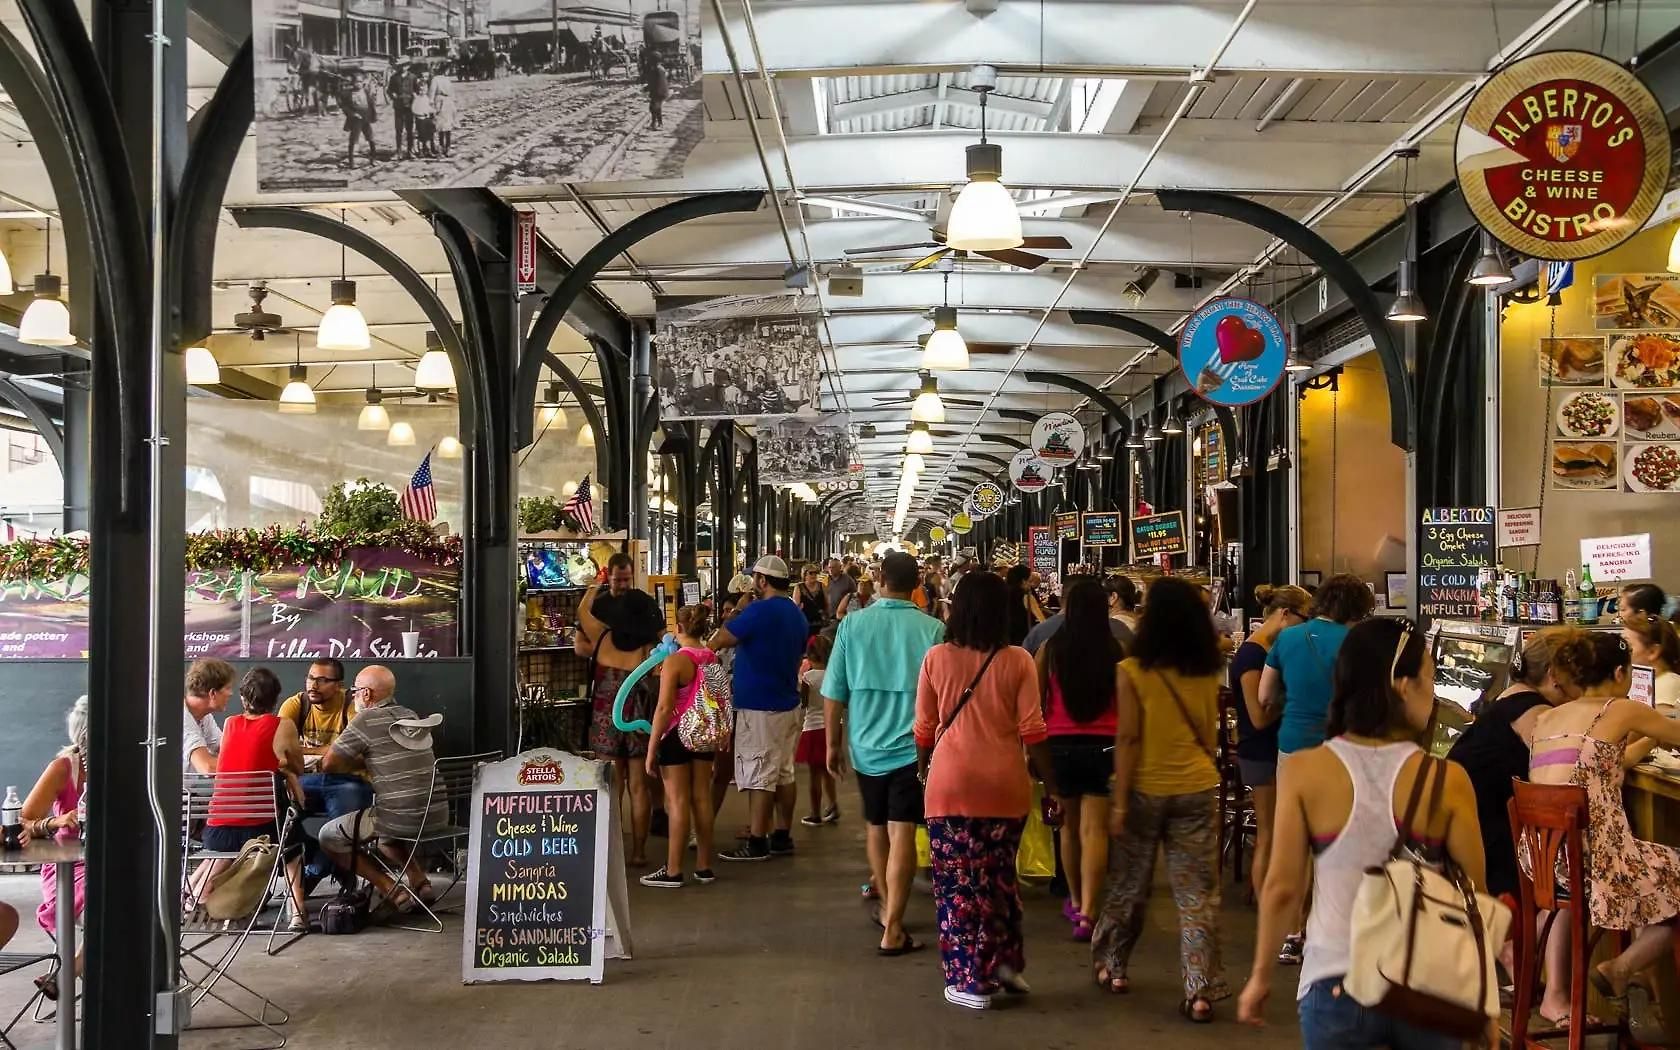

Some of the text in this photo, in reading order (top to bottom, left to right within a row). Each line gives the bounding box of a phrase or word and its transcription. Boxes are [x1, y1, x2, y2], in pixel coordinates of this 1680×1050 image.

[1494, 88, 1634, 148] ALBERTO'S
[1522, 169, 1604, 183] CHEESE
[1525, 186, 1598, 200] & WINE
[1504, 196, 1616, 238] BISTRO
[1645, 432, 1677, 440] Reuben
[976, 484, 997, 492] CAJUN
[1422, 508, 1493, 523] ALBERTOS
[1428, 528, 1484, 542] 3 Egg Cheese
[1440, 541, 1466, 552] Omelet
[1596, 542, 1637, 550] DELICIOUS
[1424, 553, 1488, 570] Organic Salads
[1420, 575, 1437, 586] ICE
[1442, 574, 1466, 586] COLD
[1430, 588, 1478, 602] SANGRIA
[1420, 604, 1479, 615] MUFFULETT
[270, 603, 301, 631] By
[0, 632, 68, 642] ade pottery
[185, 632, 230, 643] rkshops
[2, 643, 26, 652] and
[186, 643, 209, 652] and
[370, 638, 438, 658] Stuio
[484, 794, 594, 816] MUFFULETTAS
[496, 818, 536, 838] Cheese
[549, 816, 578, 835] Wine
[492, 837, 578, 858] COLD BEER
[504, 860, 556, 884] Sangria
[492, 882, 568, 901] MIMOSAS
[489, 904, 563, 924] Sandwiches
[477, 929, 504, 948] EGG
[510, 927, 587, 946] SANDWICHES
[480, 946, 579, 968] Organic Salads
